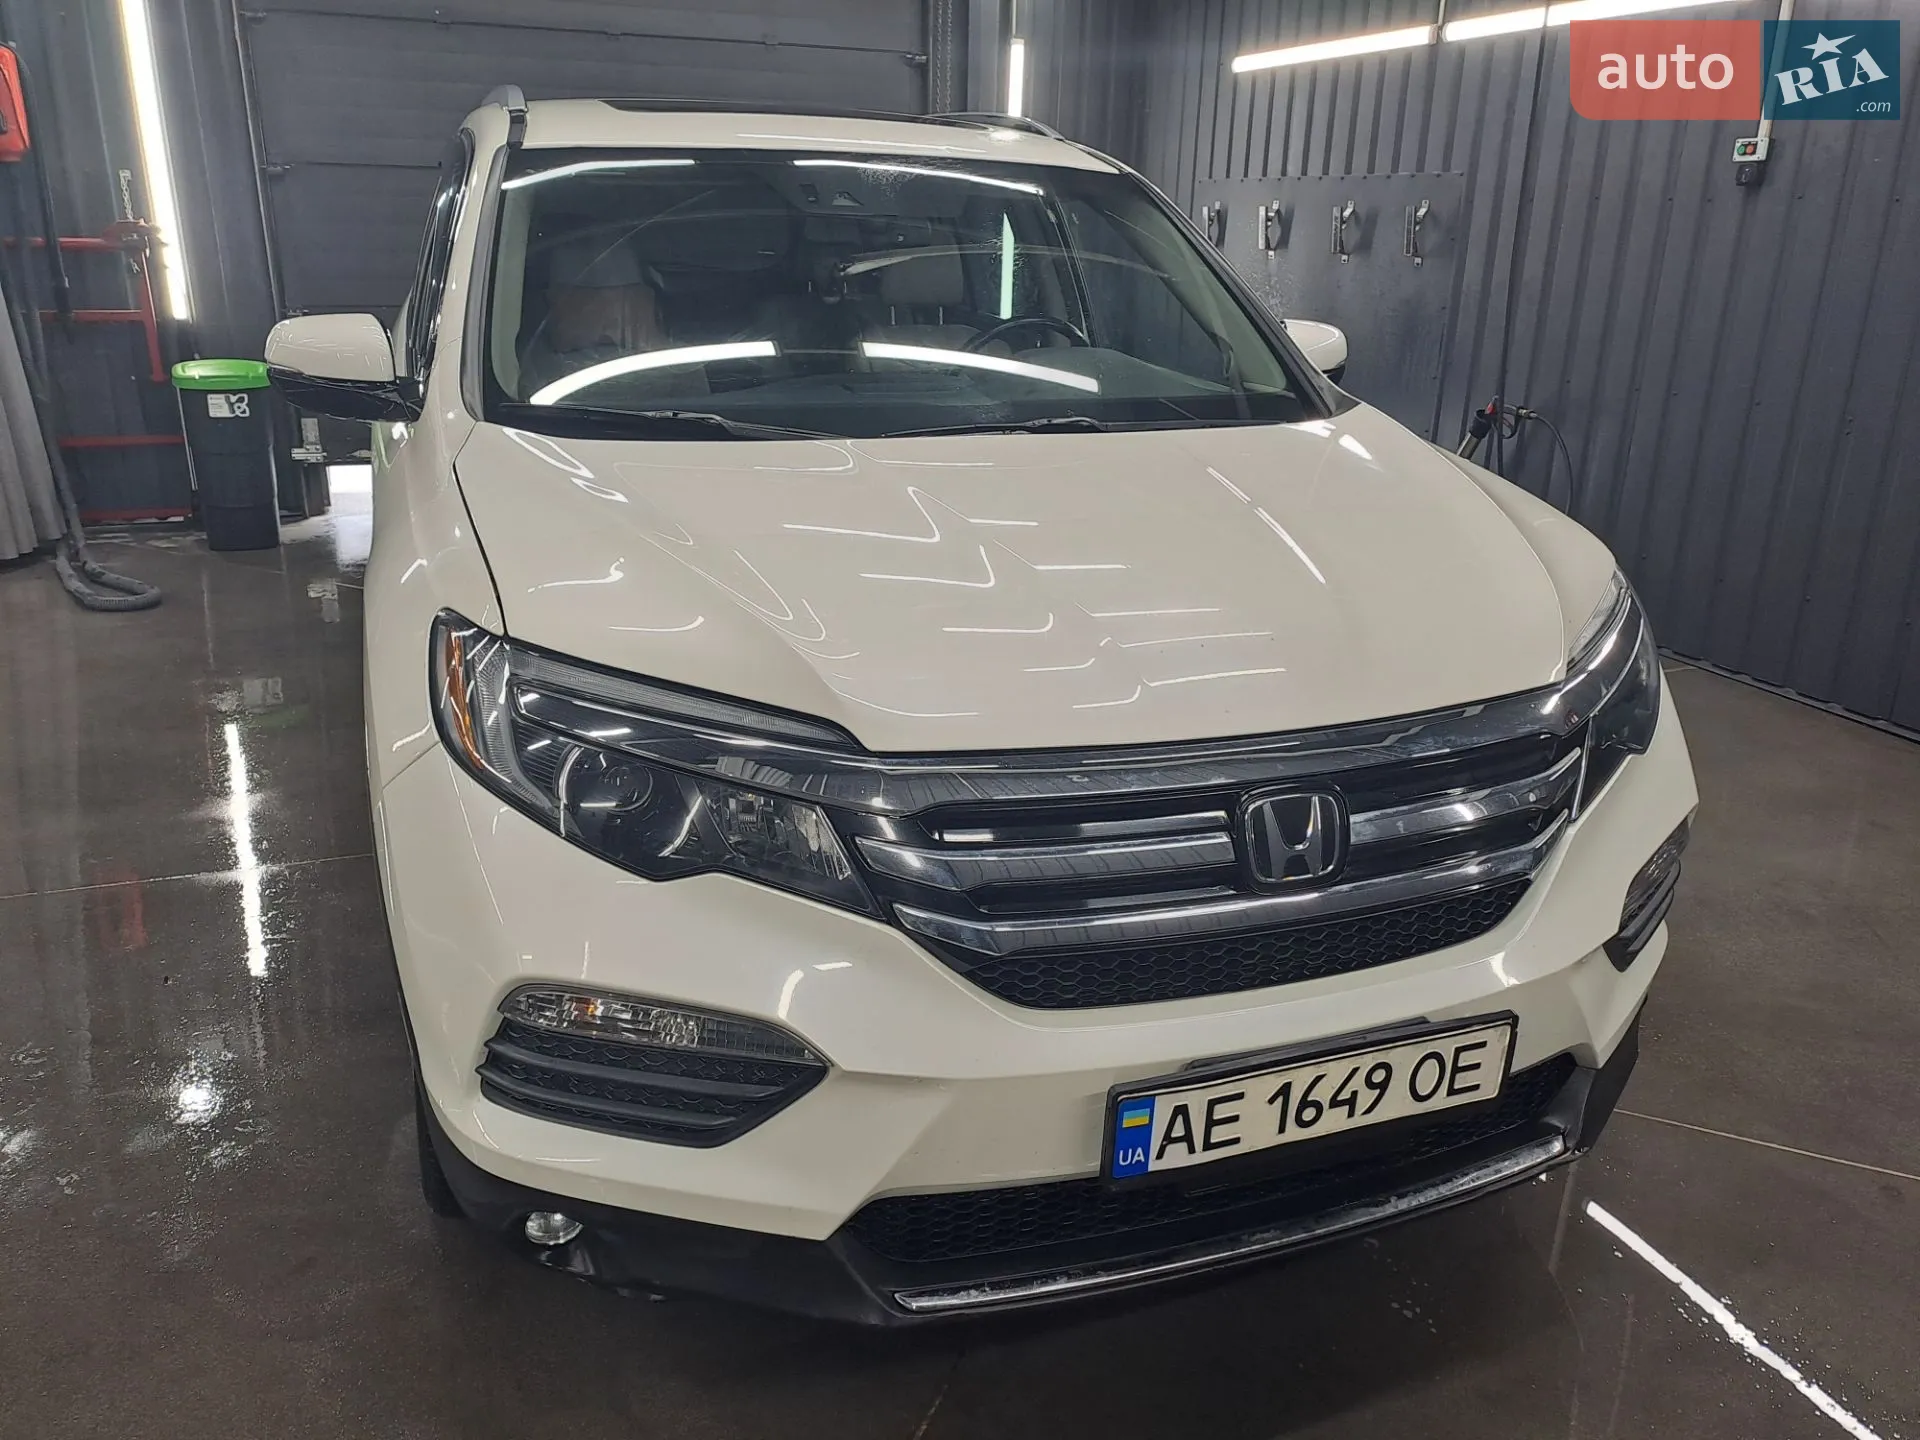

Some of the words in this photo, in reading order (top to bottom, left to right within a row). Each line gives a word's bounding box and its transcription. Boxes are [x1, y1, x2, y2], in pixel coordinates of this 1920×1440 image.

[1155, 1091, 1245, 1161] AE
[1267, 1061, 1393, 1136] 1649
[1408, 1040, 1488, 1103] OE
[1118, 1150, 1146, 1167] UA
